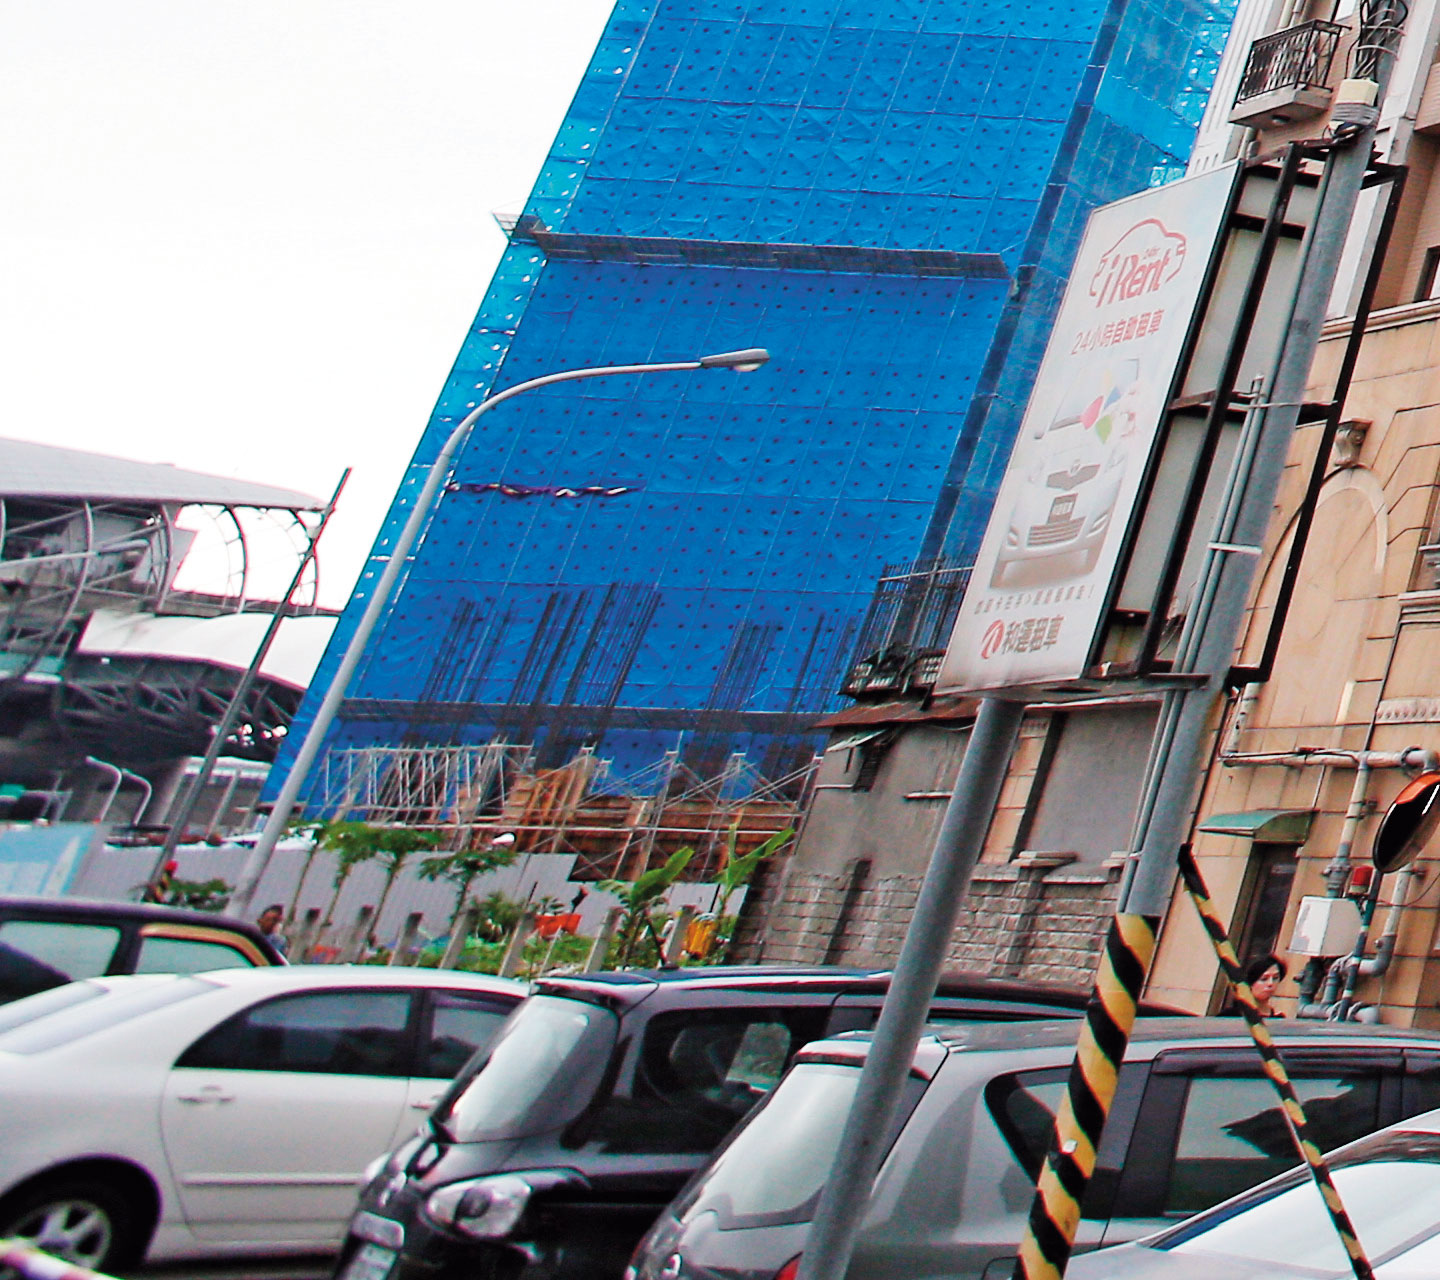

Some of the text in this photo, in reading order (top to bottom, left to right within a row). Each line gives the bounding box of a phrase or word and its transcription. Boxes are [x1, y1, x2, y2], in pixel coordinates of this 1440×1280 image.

[1071, 309, 1165, 355] 24小時自助租車
[1002, 614, 1064, 654] 和運租車
